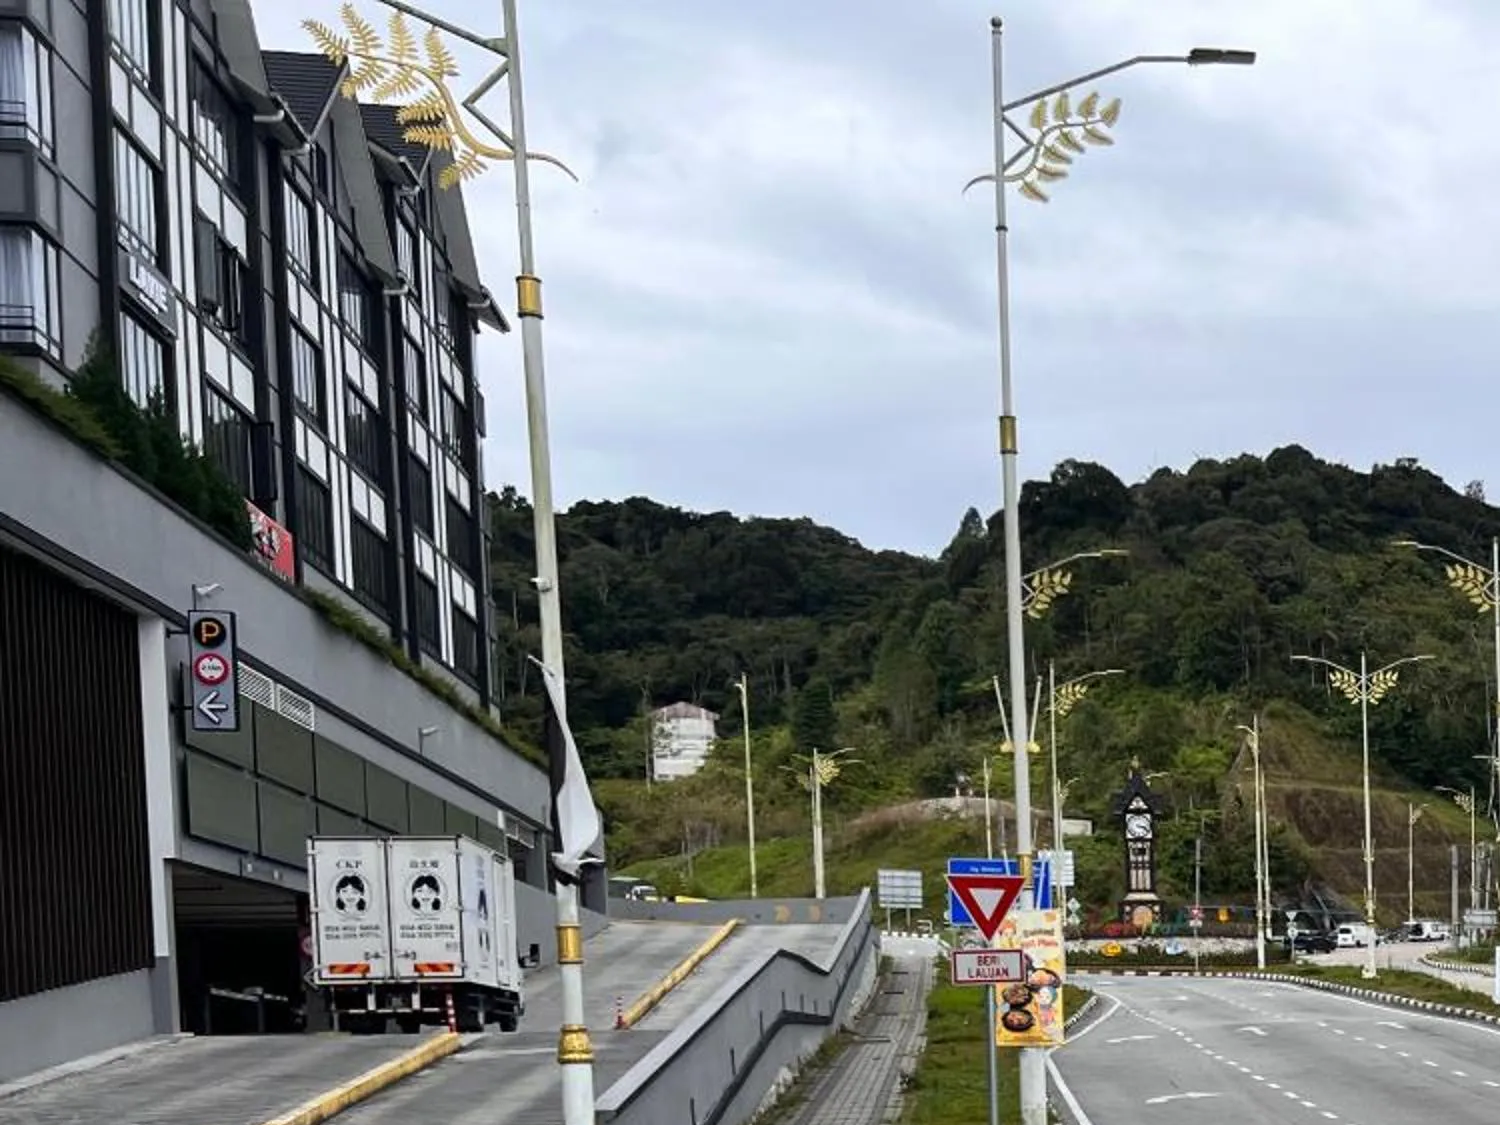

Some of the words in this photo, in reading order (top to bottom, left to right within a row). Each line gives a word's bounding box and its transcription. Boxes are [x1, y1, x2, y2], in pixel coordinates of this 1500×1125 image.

[201, 621, 219, 643] P
[977, 955, 1001, 966] BERI
[967, 967, 1009, 979] LALUAN
